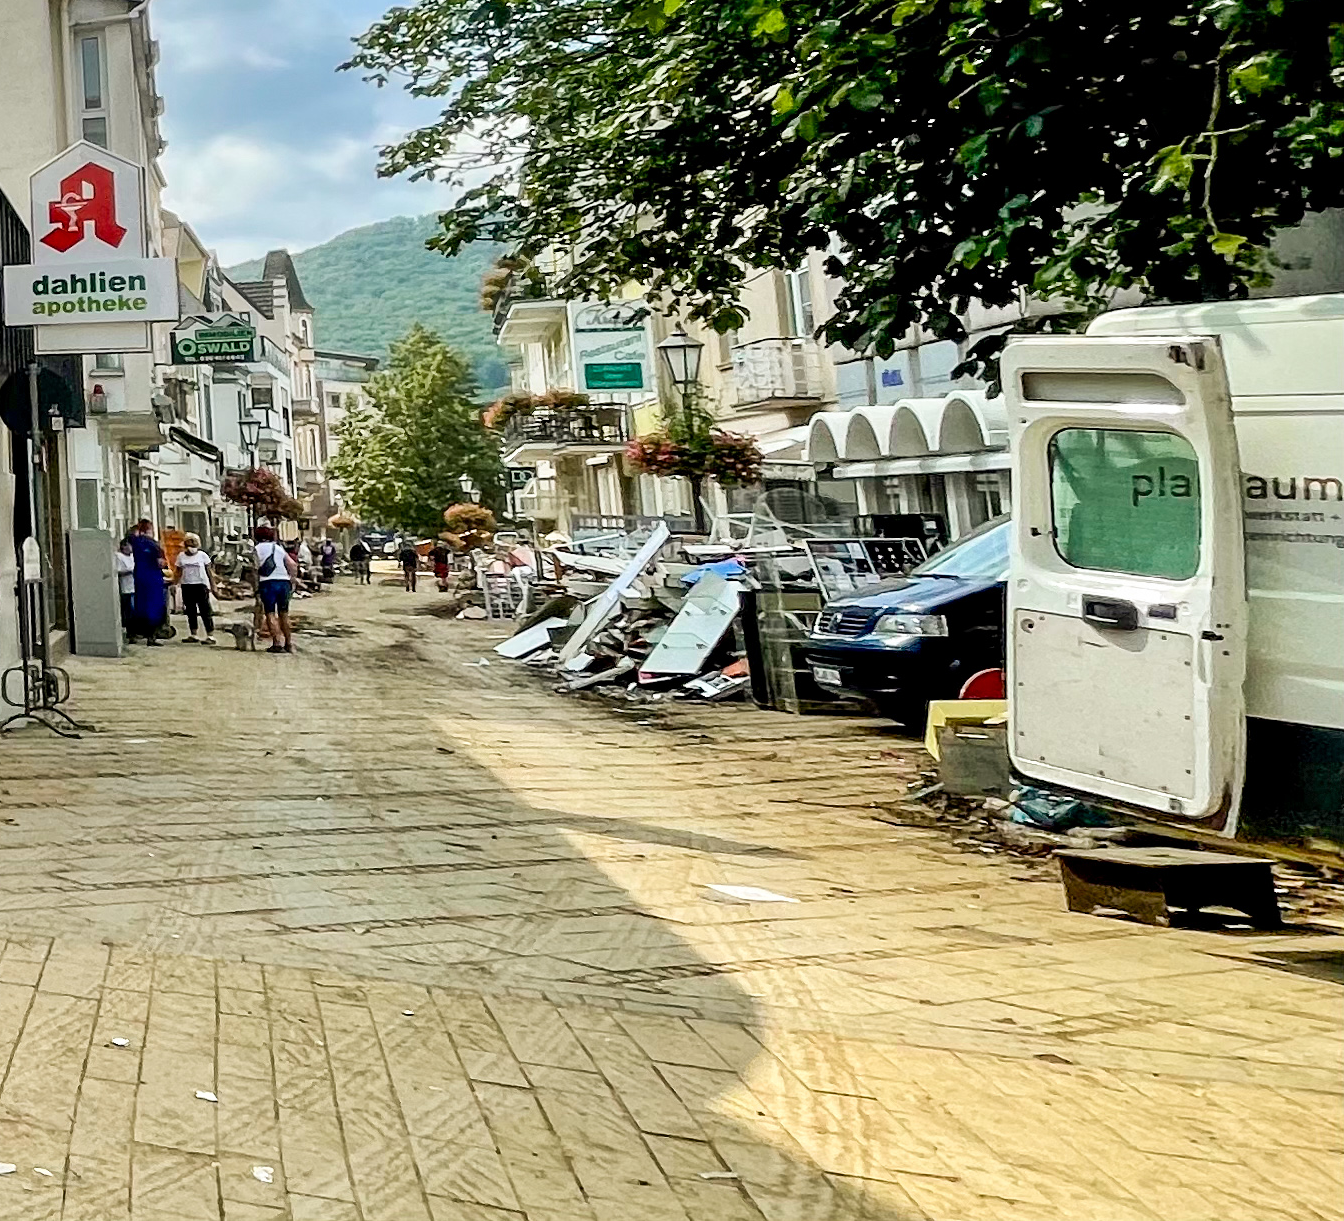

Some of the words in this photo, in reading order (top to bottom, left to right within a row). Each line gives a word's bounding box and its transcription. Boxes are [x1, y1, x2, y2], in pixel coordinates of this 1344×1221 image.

[31, 271, 147, 296] dahlien
[31, 294, 148, 317] apotheke
[177, 338, 251, 356] OSWALD
